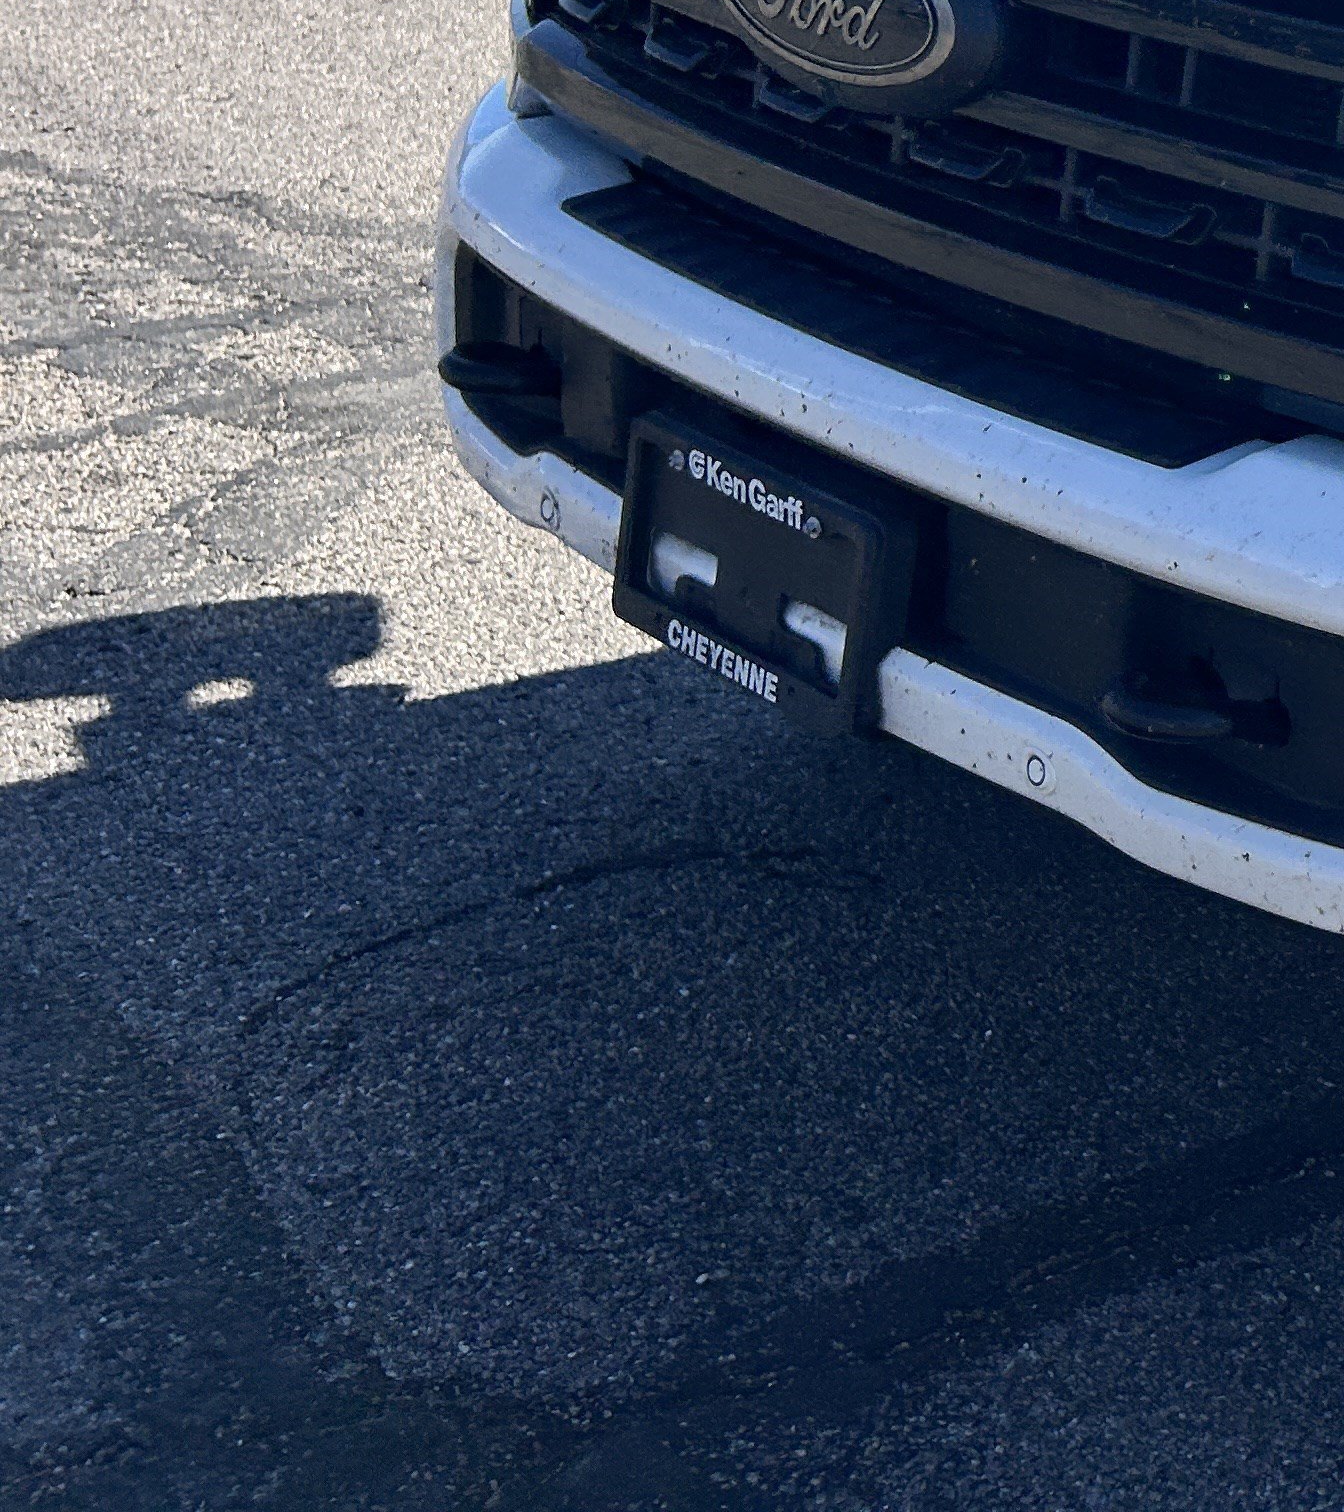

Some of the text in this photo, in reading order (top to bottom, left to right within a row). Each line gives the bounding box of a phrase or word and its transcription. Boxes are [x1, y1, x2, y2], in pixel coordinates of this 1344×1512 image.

[706, 454, 804, 531] Ken Garff
[666, 619, 779, 703] CHEYENNE
